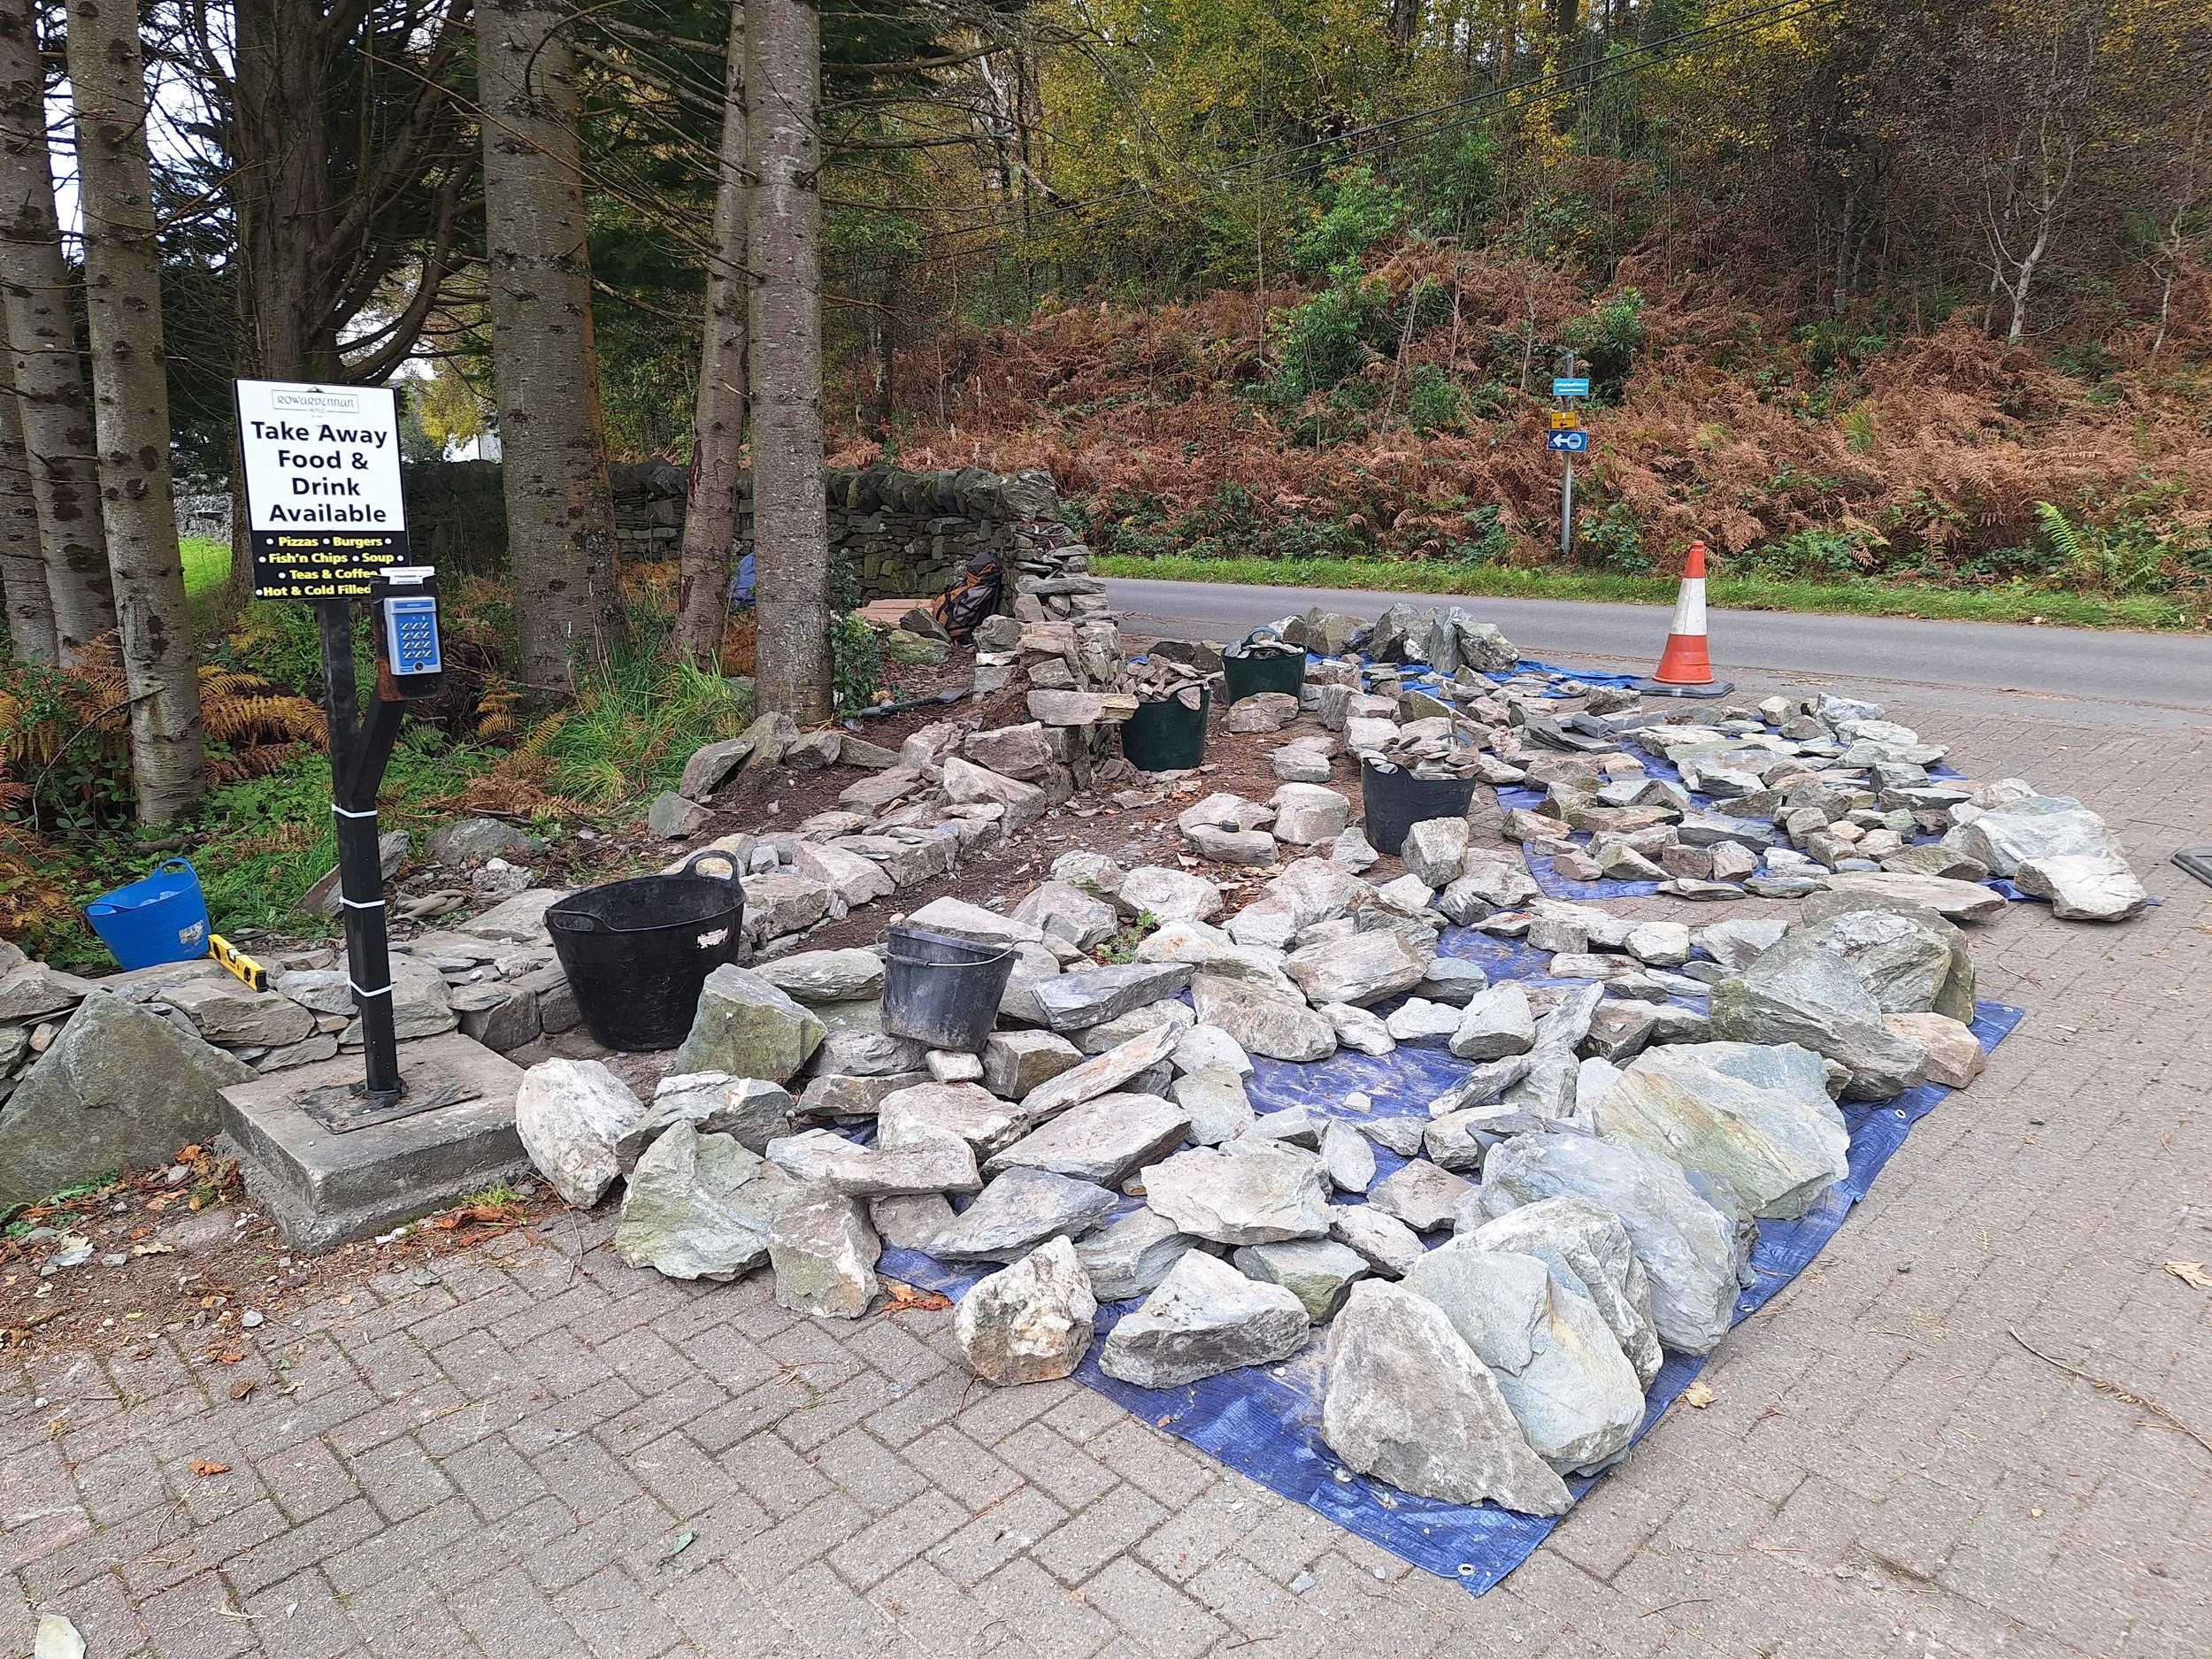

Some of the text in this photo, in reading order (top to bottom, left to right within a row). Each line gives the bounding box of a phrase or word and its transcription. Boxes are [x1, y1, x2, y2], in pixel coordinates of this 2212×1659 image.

[250, 420, 388, 449] Take Away
[278, 449, 369, 470] Food &
[292, 477, 361, 496] Drink
[269, 503, 387, 522] Available
[278, 536, 383, 549] Pizzas Burgers
[268, 552, 395, 565] Fish'n Chips Soup
[289, 569, 319, 580] Teas
[321, 569, 332, 580] &
[263, 584, 372, 596] Hot & Cold Filled
